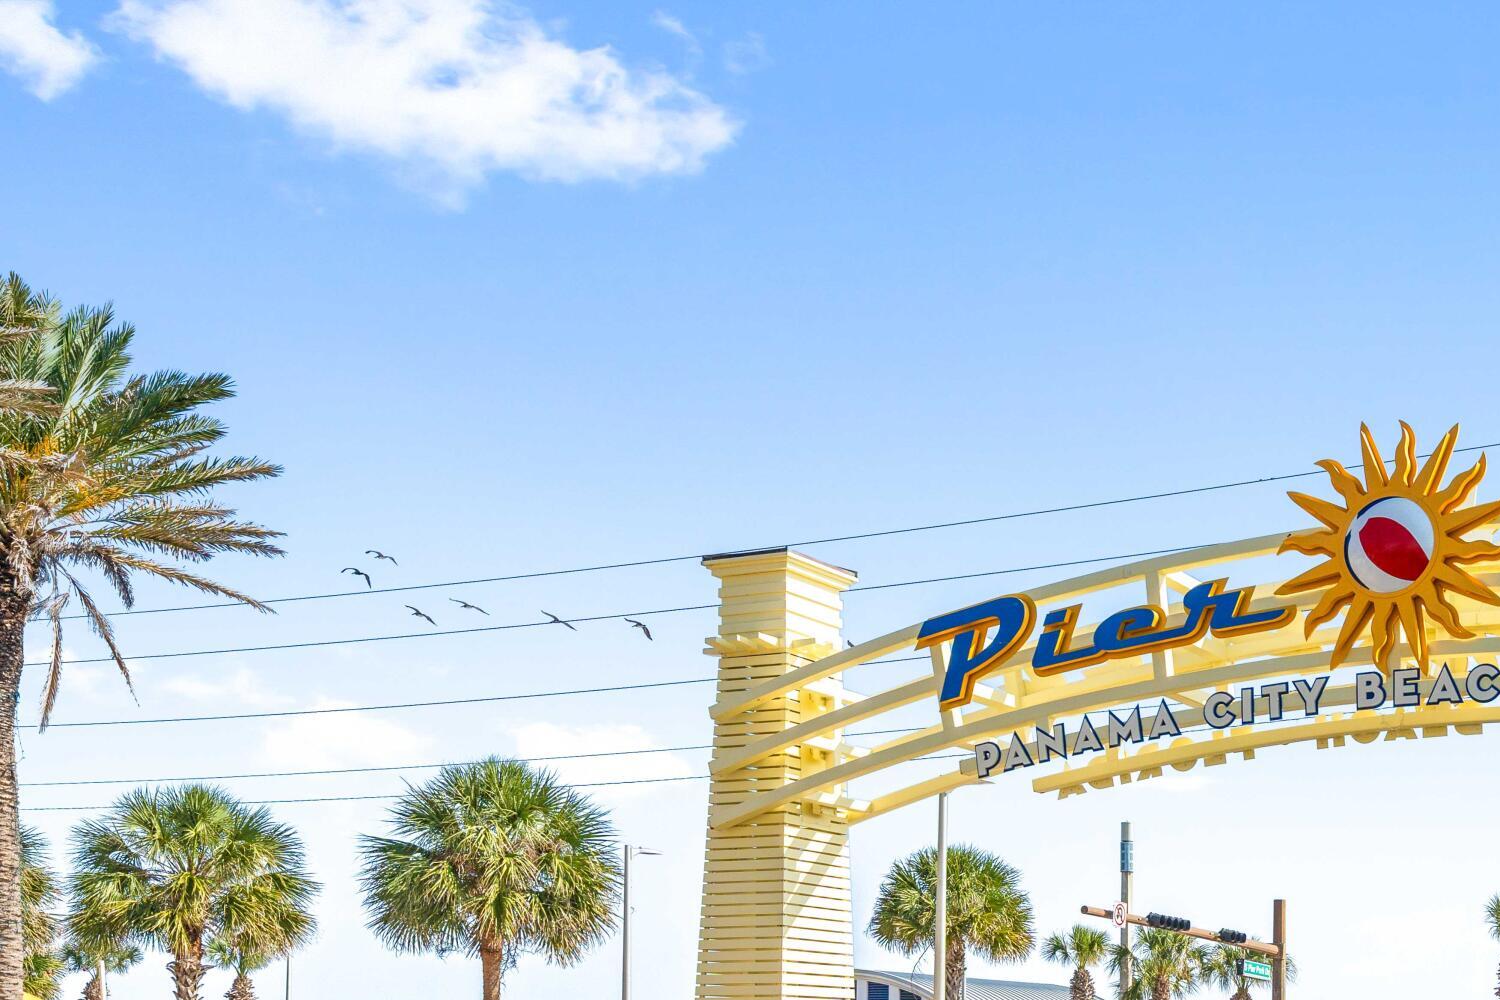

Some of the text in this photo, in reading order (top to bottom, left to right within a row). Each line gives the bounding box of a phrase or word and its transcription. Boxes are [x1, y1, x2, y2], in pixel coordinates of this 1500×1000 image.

[915, 576, 1298, 713] Pier
[974, 698, 1181, 779] PANAMA
[1203, 676, 1331, 730] CITY
